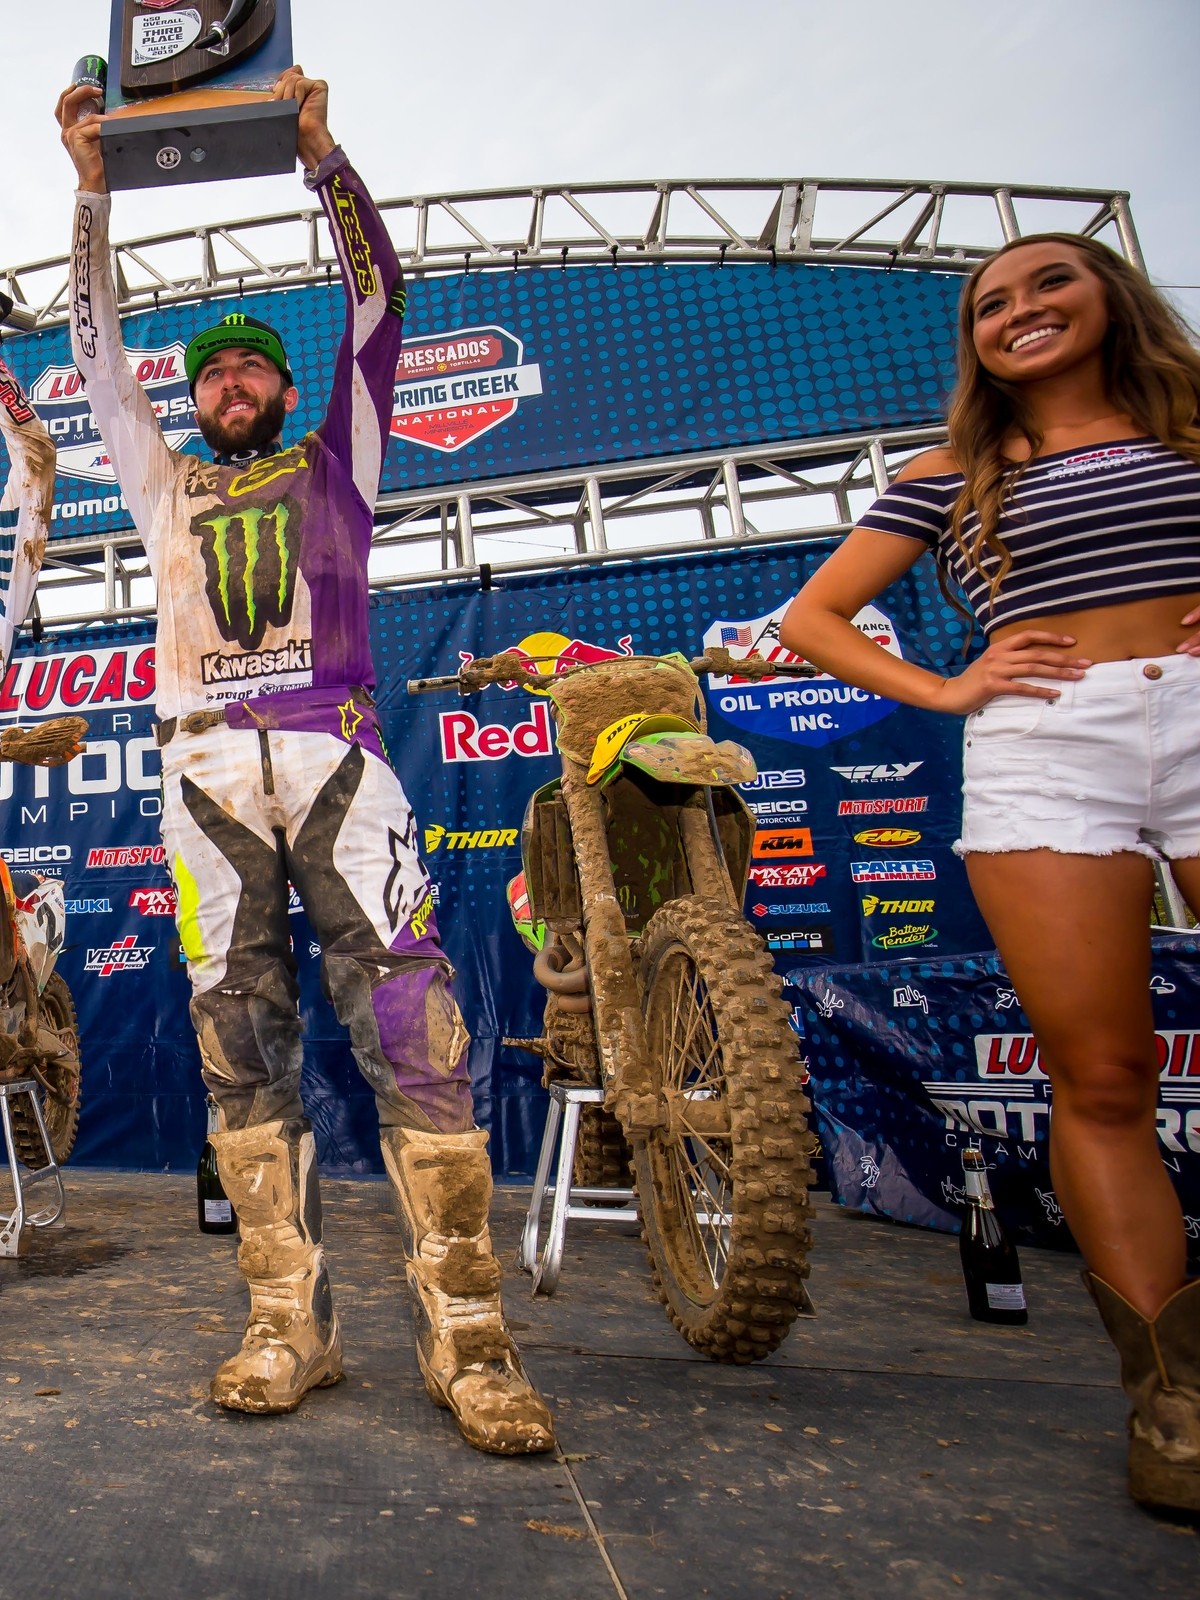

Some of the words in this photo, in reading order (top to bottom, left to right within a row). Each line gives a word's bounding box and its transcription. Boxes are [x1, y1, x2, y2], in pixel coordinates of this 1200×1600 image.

[143, 18, 183, 27] OVERALL
[142, 33, 183, 44] PLACE
[144, 26, 183, 37] THIRD
[196, 337, 270, 352] Kawasaki
[136, 356, 177, 382] OIL
[407, 366, 434, 374] PREMIUM
[449, 358, 481, 367] TORTILLAS
[393, 384, 447, 409] PRING
[451, 373, 519, 400] CREEK
[397, 405, 500, 426] NATIONAL
[424, 424, 475, 435] MINNESOTA
[428, 419, 469, 430] MILLVILLE
[203, 640, 313, 683] Kawasaki
[720, 694, 761, 713] OIL
[790, 713, 839, 731] INC.
[441, 703, 550, 761] Red
[842, 761, 925, 780] FLY
[446, 828, 519, 850] THOR
[760, 836, 803, 851] KTM
[855, 830, 921, 845] FMF
[749, 866, 779, 881] MX
[786, 865, 826, 879] ATV
[851, 860, 934, 875] PARTS
[759, 878, 785, 887] ALL
[786, 877, 809, 886] OUT
[853, 872, 936, 883] UNLIMITED
[65, 899, 109, 914] ZUKI
[143, 905, 171, 916] ALL
[880, 899, 935, 913] THOR
[767, 932, 822, 942] GoPro
[889, 924, 930, 936] Battery
[880, 934, 925, 949] Tender
[87, 947, 154, 963] VERTEX
